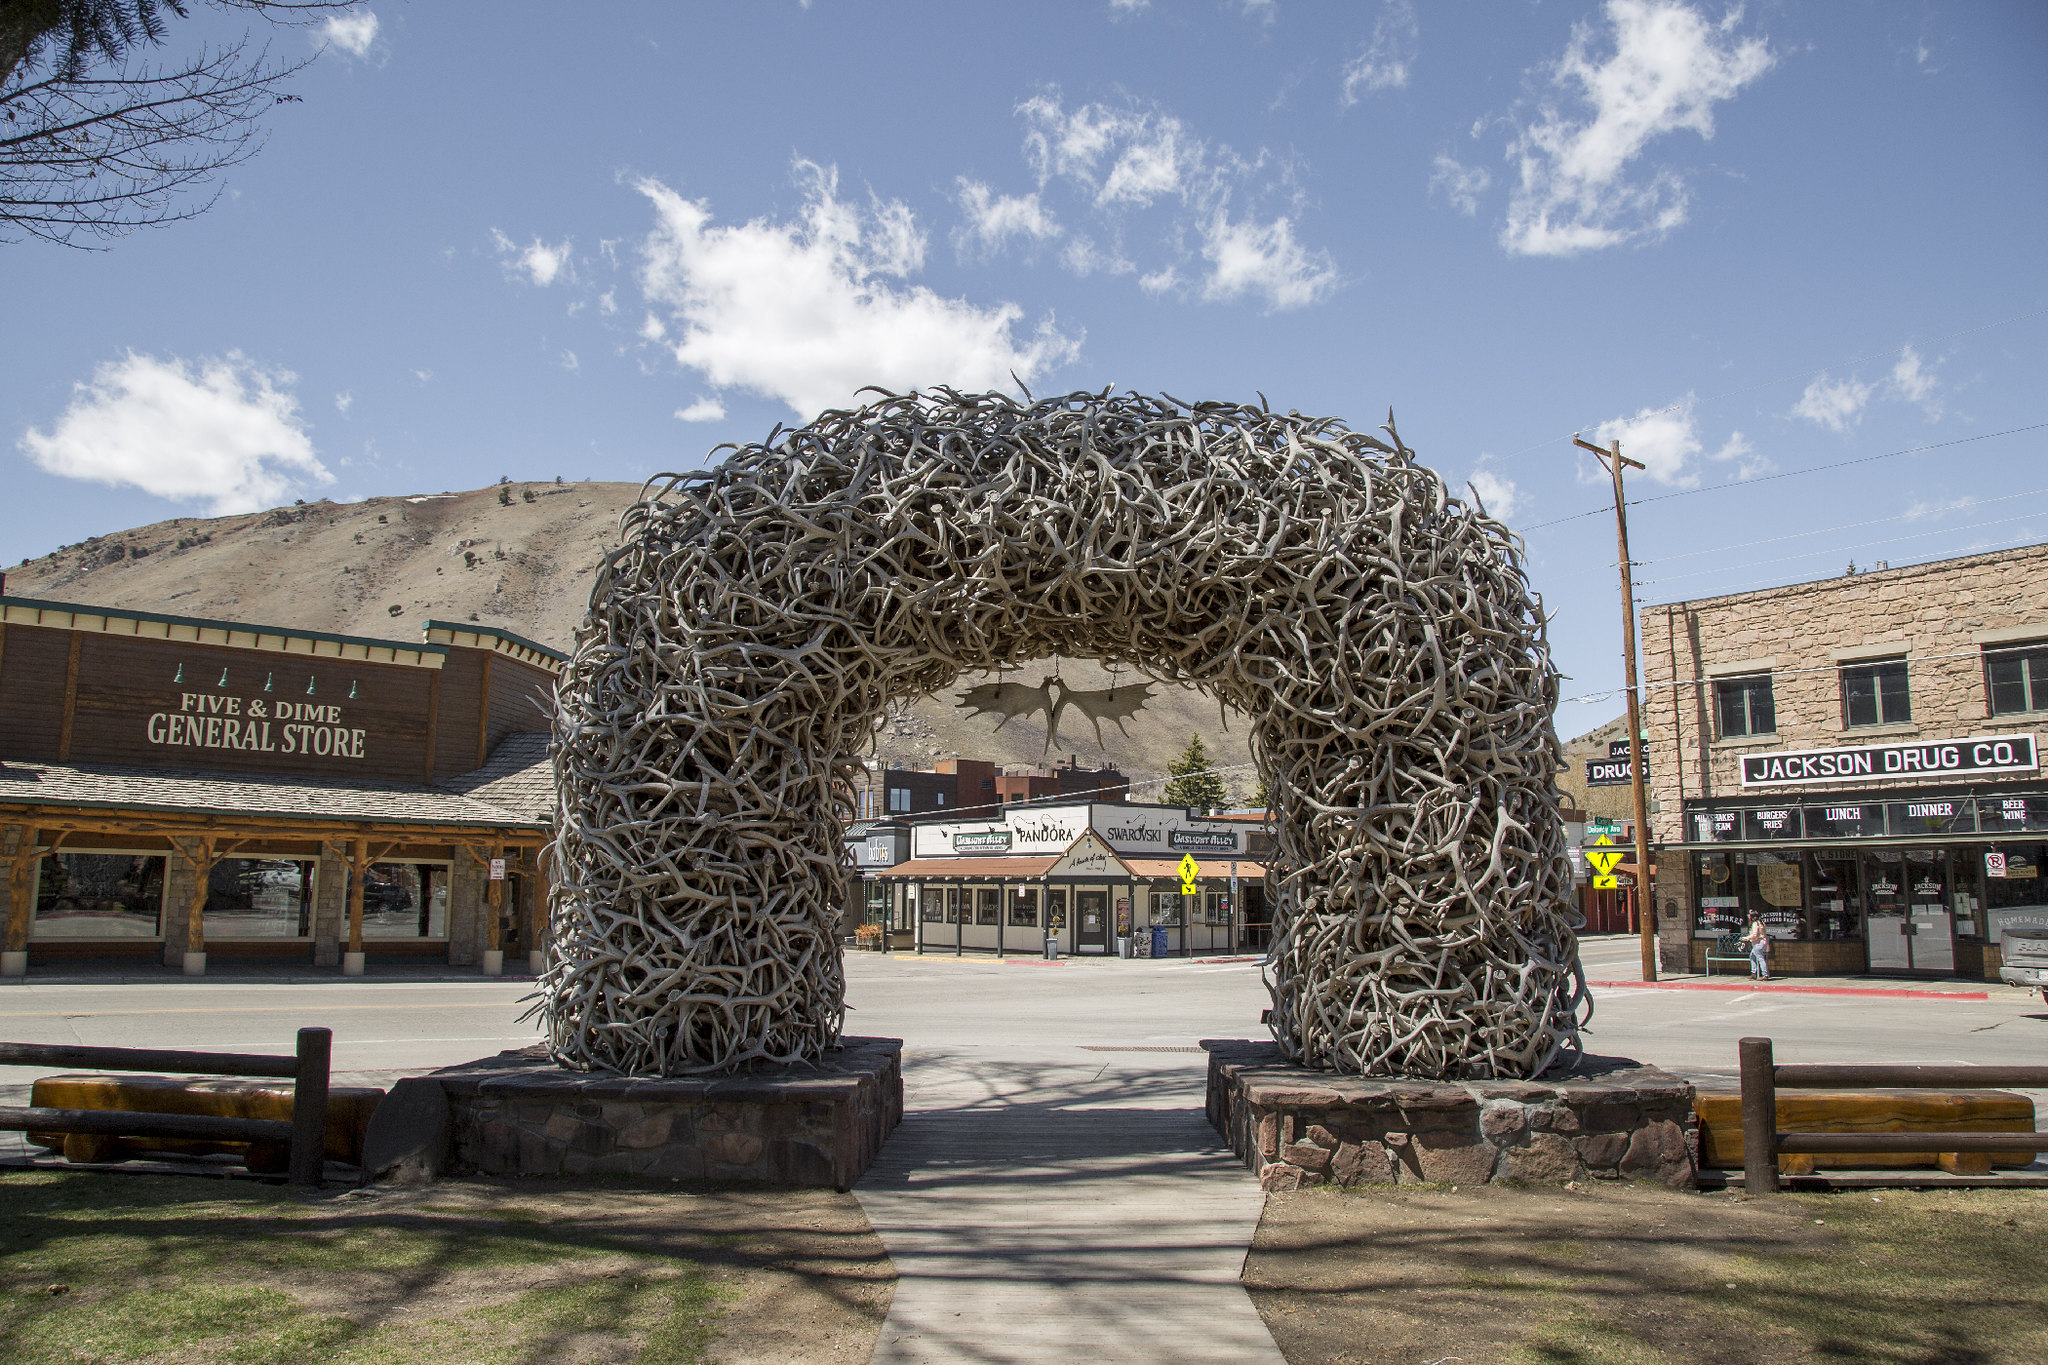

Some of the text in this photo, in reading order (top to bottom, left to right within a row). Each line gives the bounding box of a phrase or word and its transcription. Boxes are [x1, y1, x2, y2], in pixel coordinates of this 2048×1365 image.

[181, 693, 342, 724] FIVE & DIME
[147, 713, 366, 758] GENERAL STORE
[1612, 745, 1650, 755] JACO
[1753, 742, 2020, 780] JACKSON DRUG CO.
[2002, 800, 2026, 809] BEER
[1825, 807, 1862, 821] LUNCH
[1908, 803, 1954, 817] DINNER
[2003, 810, 2027, 820] WINE
[1756, 811, 1788, 820] BURGERS
[1763, 820, 1783, 829] FRIES
[987, 834, 1008, 845] ALLEY
[1020, 829, 1074, 842] PANDORA
[1107, 827, 1161, 842] SWAROVSKI
[1210, 835, 1234, 845] ALLEY
[1871, 883, 1898, 891] JACKSON
[1914, 883, 1942, 891] JACKSON
[1698, 914, 1744, 926] MILKSHAKES
[2017, 943, 2048, 952] RA
